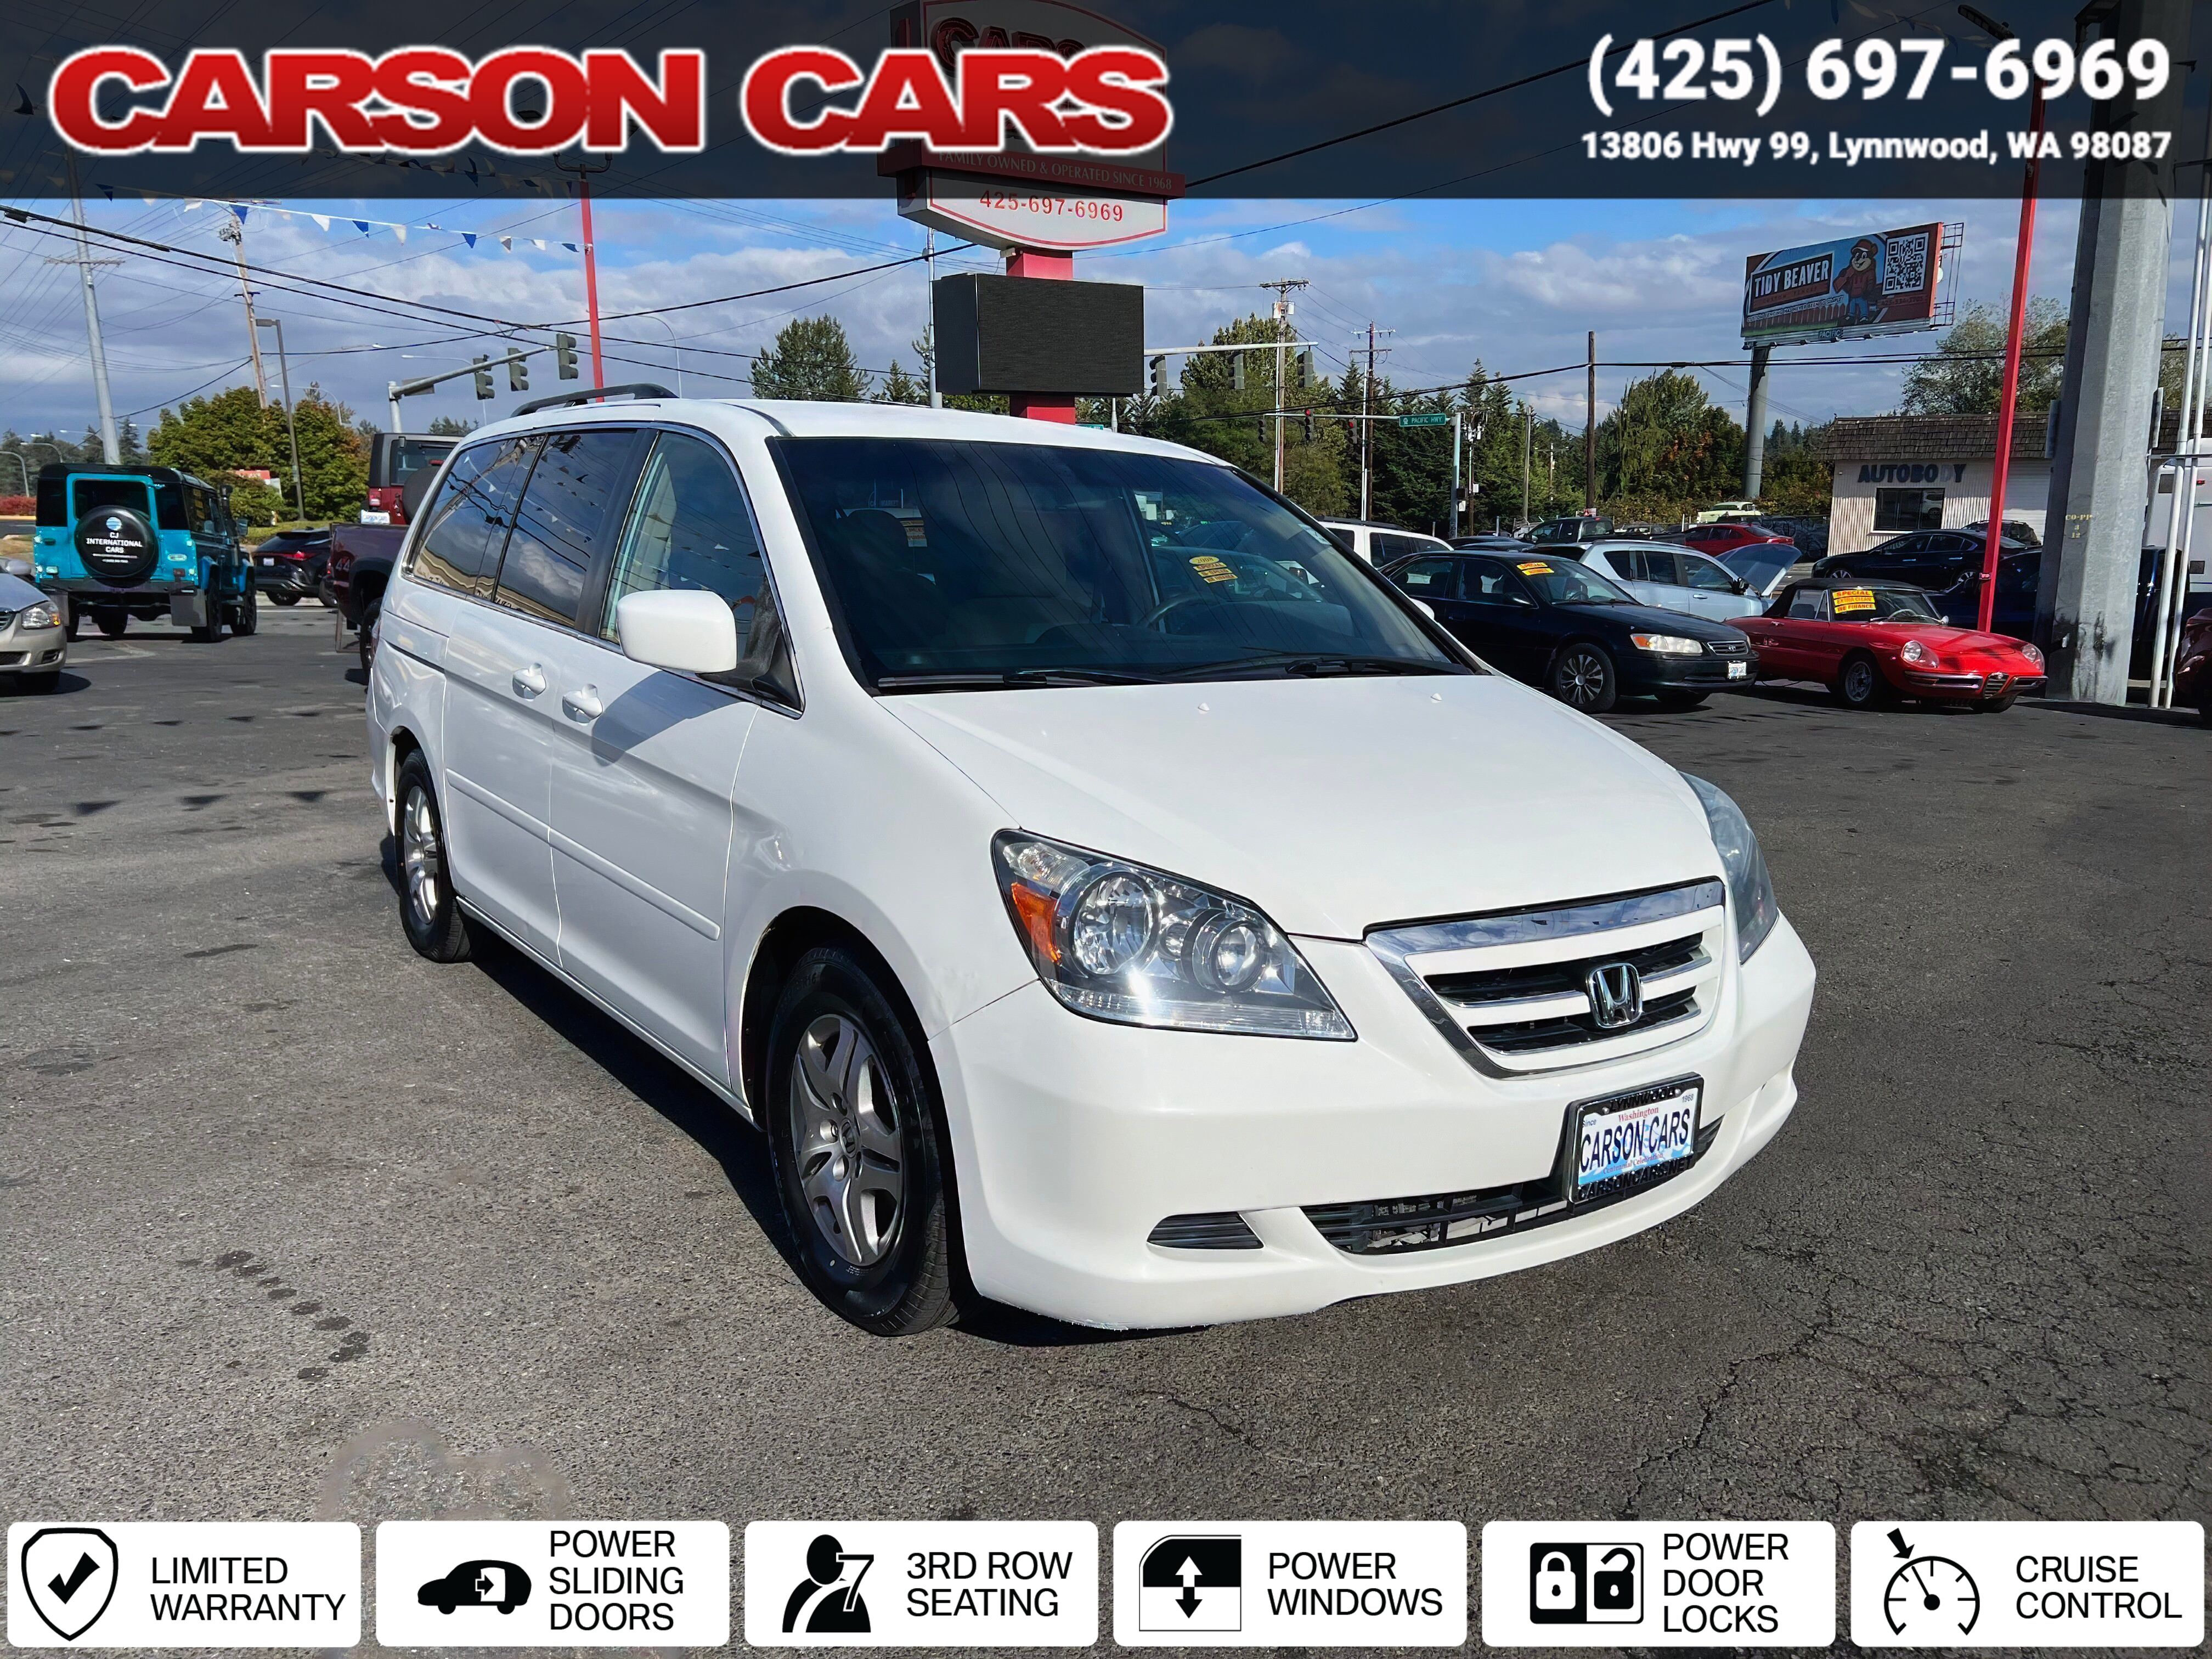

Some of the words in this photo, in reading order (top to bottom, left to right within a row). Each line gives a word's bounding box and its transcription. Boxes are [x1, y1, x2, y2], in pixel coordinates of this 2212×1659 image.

[939, 151, 983, 166] FAMILY
[987, 156, 1036, 173] OWNED
[1040, 164, 1048, 174] &
[1051, 164, 1109, 183] OPERATED
[1113, 171, 1145, 188] SINCE
[1148, 176, 1172, 190] 1968
[979, 190, 1123, 222] 425-697-6969
[1754, 272, 1781, 297] TIDY
[1784, 260, 1829, 290] BEAVER
[1791, 303, 1807, 313] NEVER
[1819, 329, 1841, 338] PACIFIC
[86, 538, 143, 548] INTERNATIONAL
[1609, 1086, 1674, 1111] LYNNWOOD
[1618, 1107, 1659, 1123] Washington
[1581, 1119, 1646, 1173] CARSON
[1649, 1108, 1690, 1153] CARS
[1602, 1158, 1632, 1175] Centennial
[1633, 1153, 1664, 1167] Celebration
